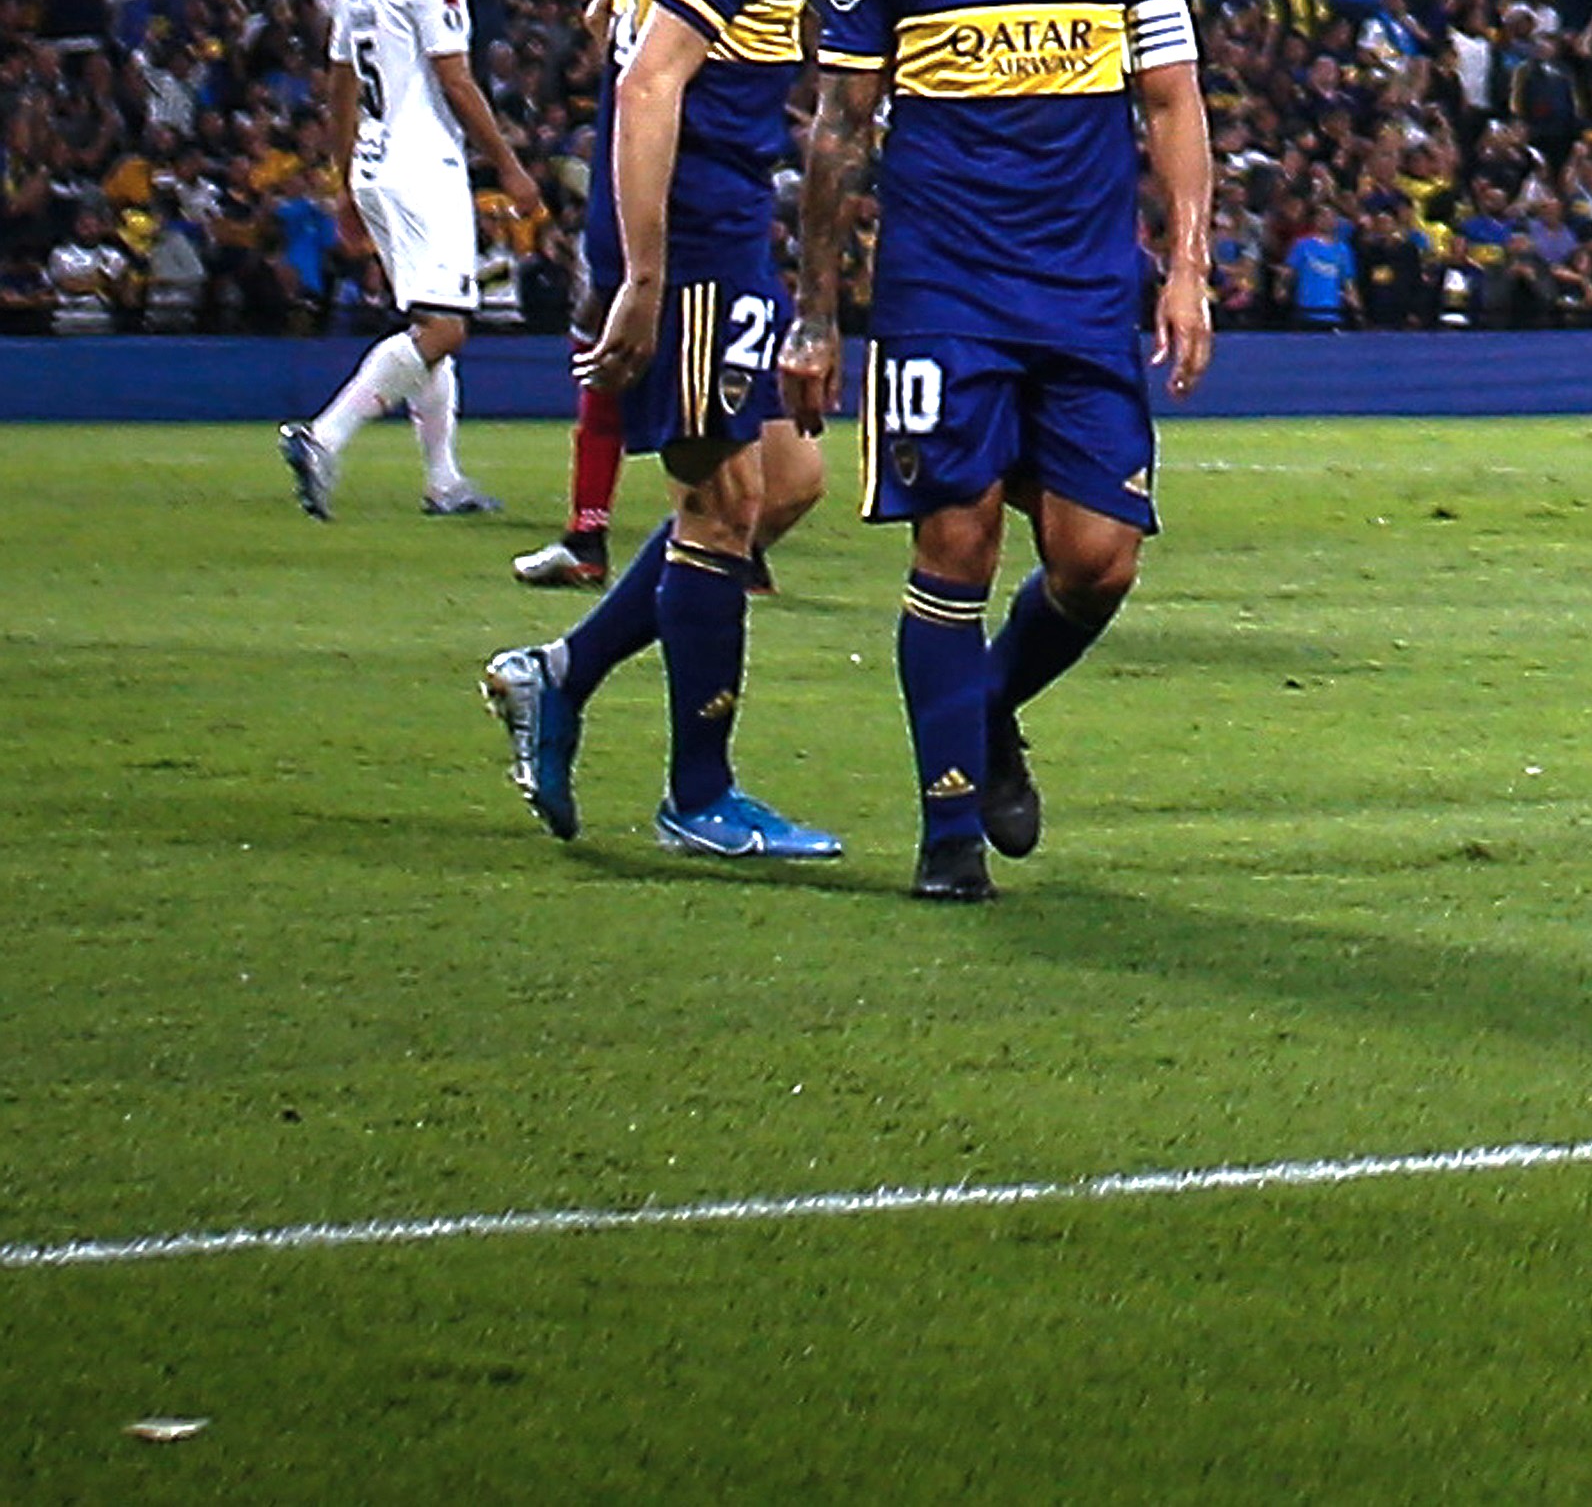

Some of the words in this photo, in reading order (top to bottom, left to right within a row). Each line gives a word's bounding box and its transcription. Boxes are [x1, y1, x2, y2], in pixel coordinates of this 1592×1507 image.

[951, 18, 1093, 62] QATAR
[991, 55, 1093, 78] AIRWAYS
[354, 34, 386, 121] 5
[884, 358, 943, 433] 10
